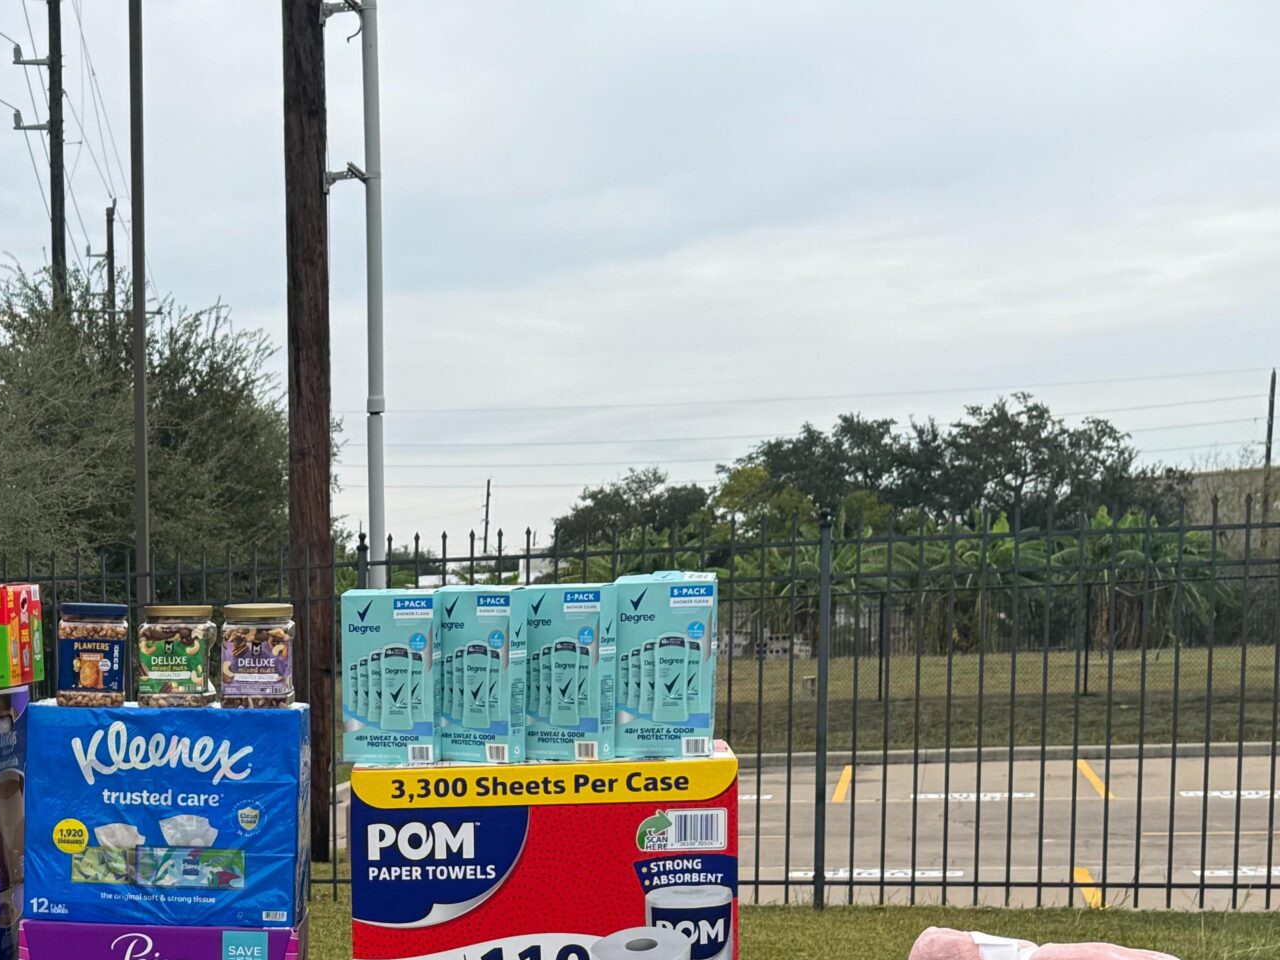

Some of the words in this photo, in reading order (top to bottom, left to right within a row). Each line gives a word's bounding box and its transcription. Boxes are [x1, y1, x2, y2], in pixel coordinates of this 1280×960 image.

[673, 588, 707, 596] 5-PACK
[620, 613, 656, 624] Degree
[349, 624, 380, 634] Degree
[74, 642, 109, 650] PLANTERS
[151, 656, 187, 665] DELUXE
[71, 721, 253, 785] Kleenex
[391, 778, 468, 803] 3,300
[475, 775, 566, 797] Sheets
[574, 773, 619, 793] Per
[625, 771, 690, 792] Case
[103, 789, 172, 805] trusted
[177, 793, 220, 807] care
[59, 829, 83, 838] 1,920
[58, 837, 85, 845] tissues!
[367, 822, 476, 861] POM
[645, 836, 668, 844] SCAN
[650, 858, 702, 872] STRONG
[368, 866, 422, 881] PAPER
[425, 864, 496, 880] TOWELS
[652, 872, 724, 886] ABSORBENT
[114, 893, 142, 901] original
[144, 893, 158, 901] soft
[168, 895, 191, 904] strong
[193, 896, 216, 904] tissue
[228, 946, 261, 956] SAVE
